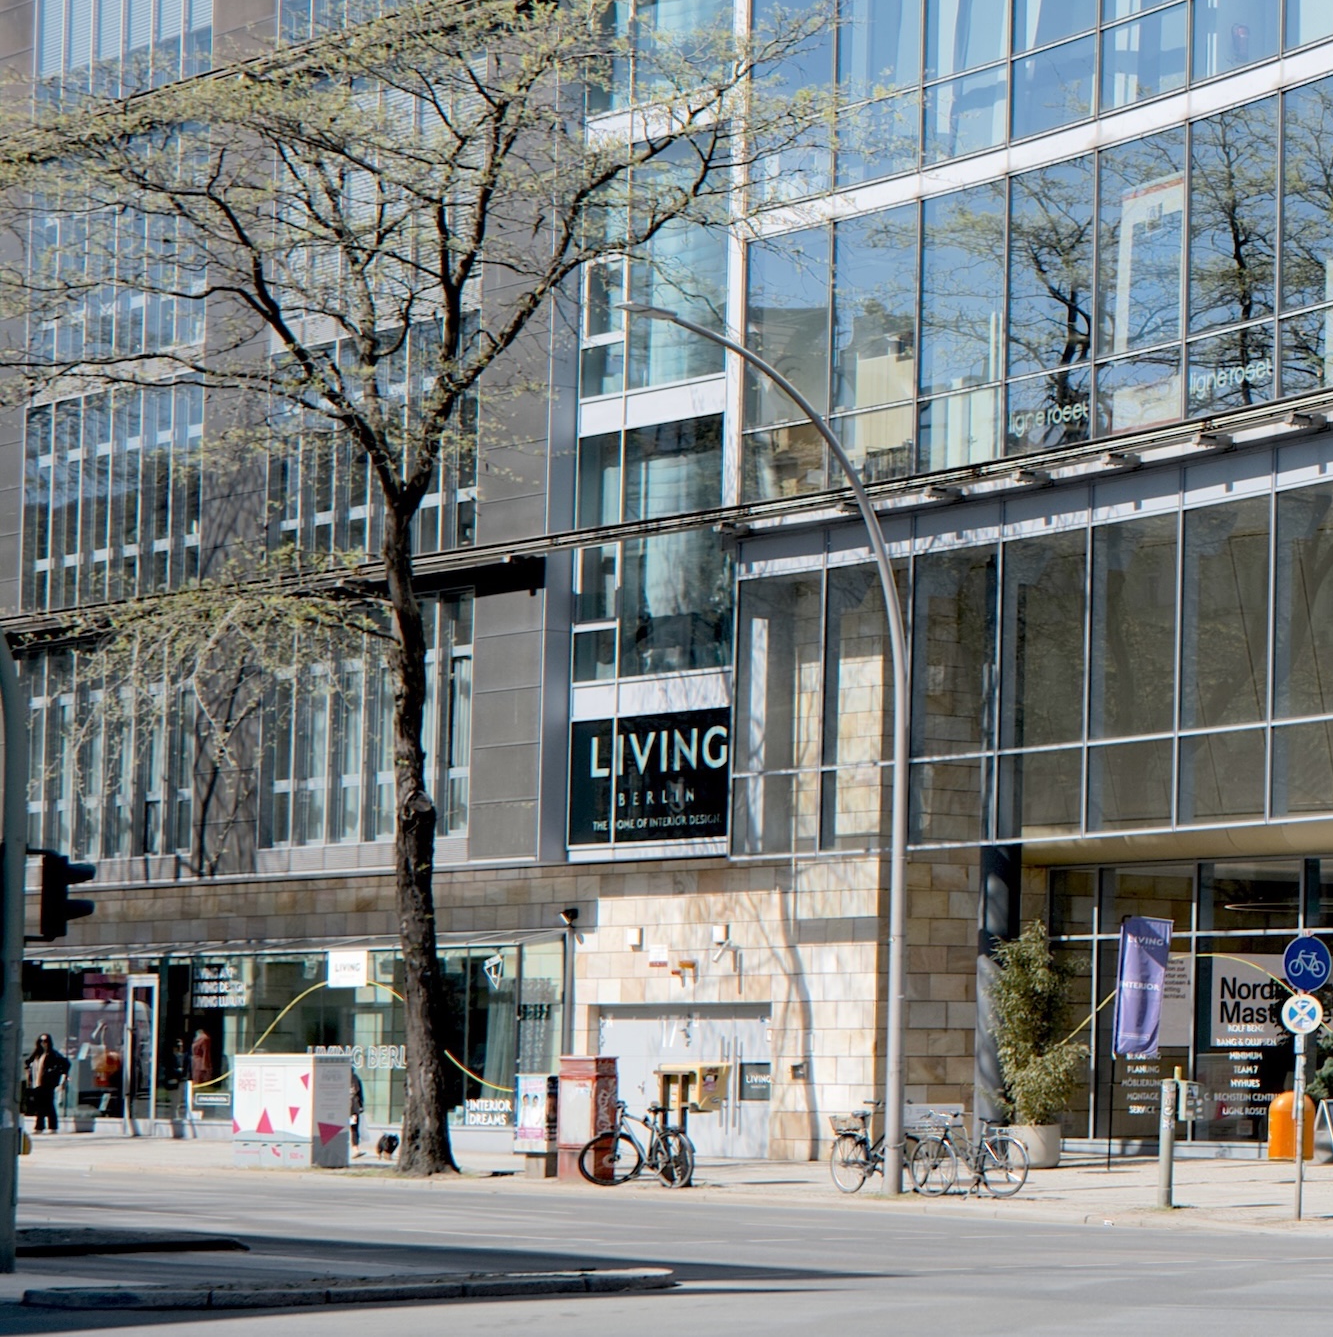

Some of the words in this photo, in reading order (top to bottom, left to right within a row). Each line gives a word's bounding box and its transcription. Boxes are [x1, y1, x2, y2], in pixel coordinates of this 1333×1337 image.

[1189, 369, 1226, 399] ligne
[1228, 359, 1273, 384] roset
[590, 725, 728, 778] LIVING
[618, 788, 695, 807] BERLIN
[592, 820, 608, 831] THE
[636, 818, 648, 829] OF
[650, 816, 687, 828] INTERIOR
[1127, 934, 1164, 947] LIVING
[1220, 977, 1282, 1000] Nord
[367, 1045, 407, 1069] BERL
[1127, 1091, 1159, 1100] MONTAGE
